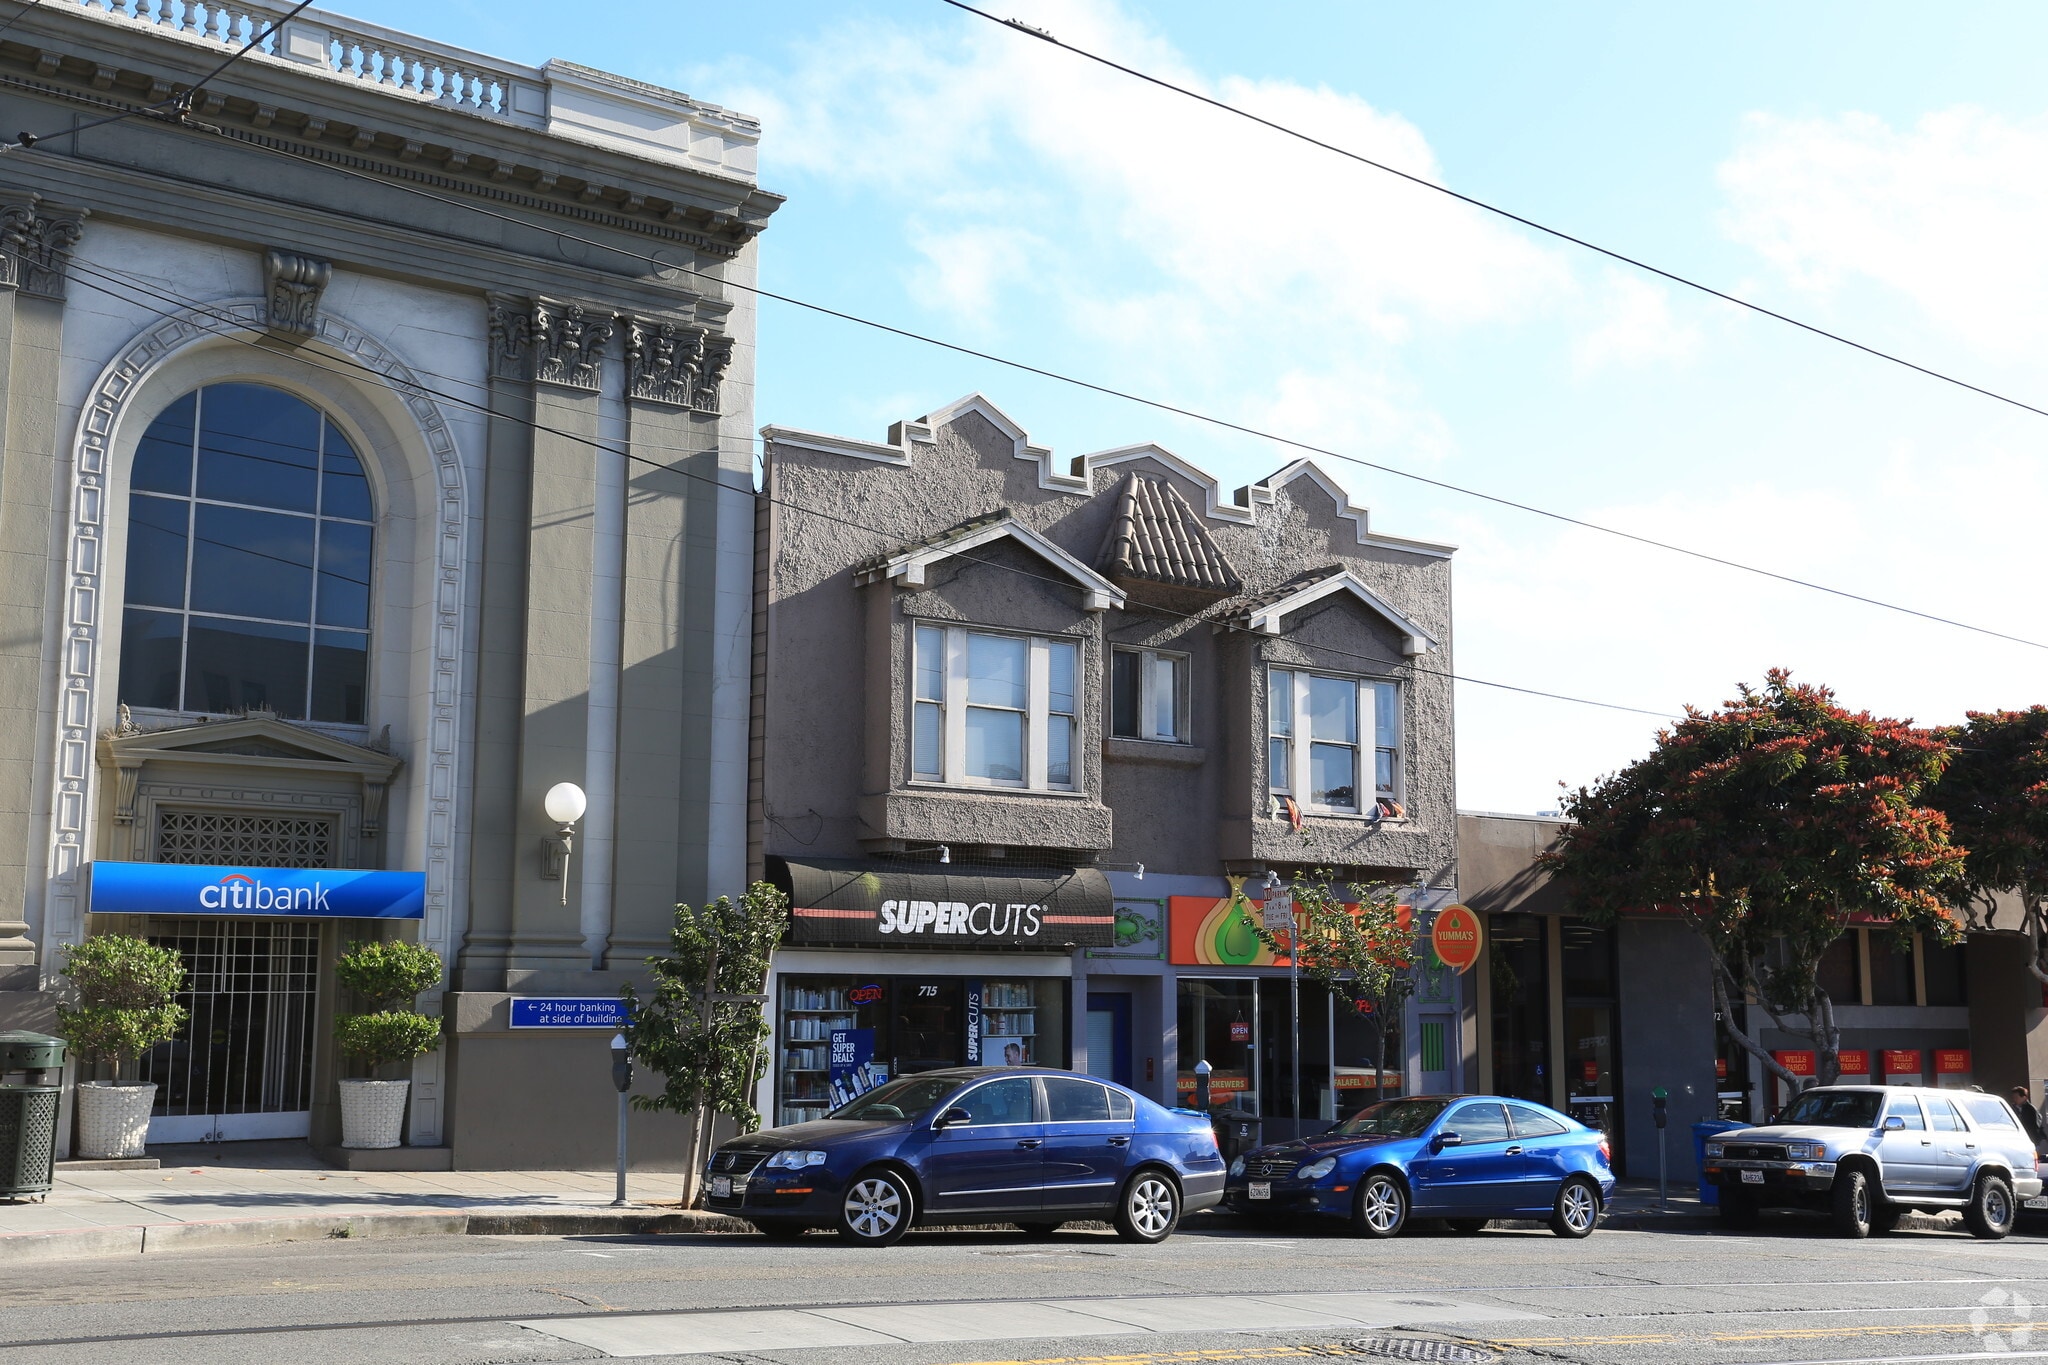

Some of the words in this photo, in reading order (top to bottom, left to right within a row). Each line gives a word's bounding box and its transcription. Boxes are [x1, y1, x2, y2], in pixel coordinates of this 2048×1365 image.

[200, 879, 330, 910] citibank
[1264, 888, 1270, 901] NO
[1271, 890, 1289, 898] PARKIN
[1438, 931, 1473, 940] YUMMA'S
[850, 988, 882, 1001] OPEN
[918, 986, 937, 996] 715
[540, 1003, 552, 1012] 24
[555, 1003, 577, 1012] hour
[580, 1003, 616, 1014] banking
[540, 1015, 549, 1023] at
[555, 1014, 571, 1023] side
[574, 1014, 584, 1023] of
[968, 992, 979, 1061] SUPERCUTS
[832, 1033, 846, 1043] GET
[832, 1043, 855, 1053] SUPER
[832, 1053, 854, 1063] DEALS
[1840, 1063, 1861, 1071] FARGO
[1177, 1081, 1197, 1089] ALAD
[1211, 1080, 1244, 1088] SKEWERS
[1334, 1078, 1361, 1086] FALAFEL
